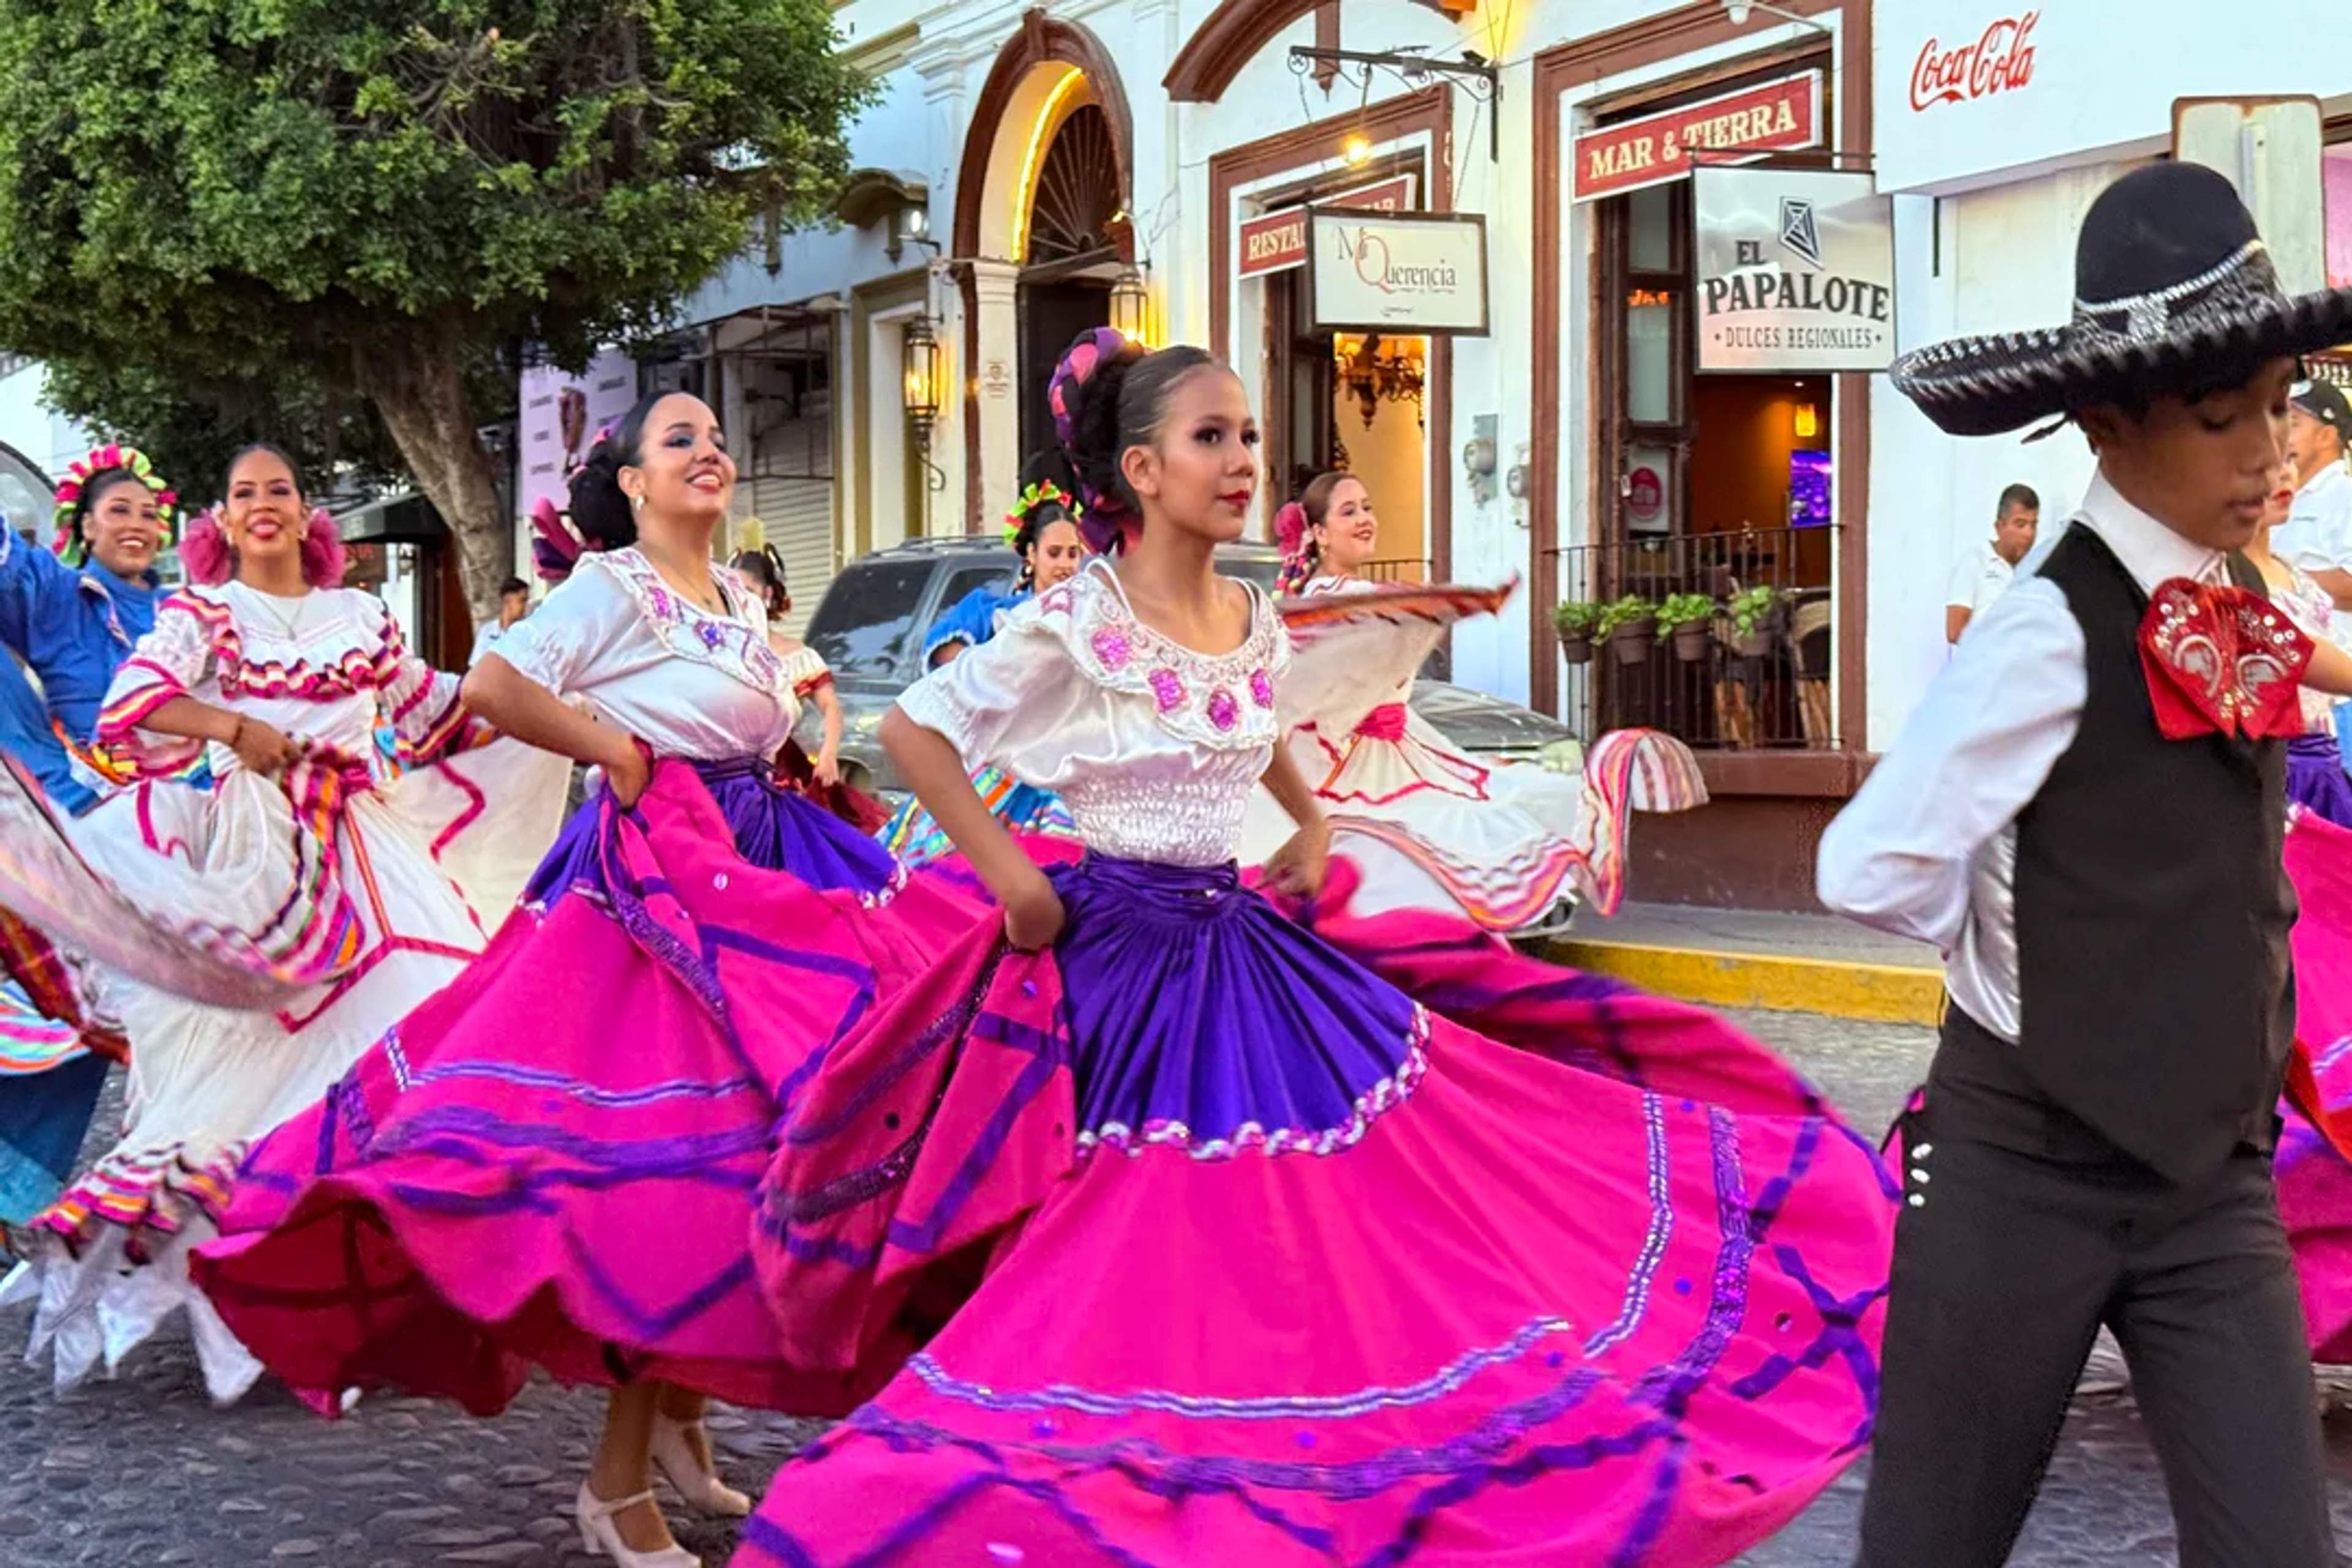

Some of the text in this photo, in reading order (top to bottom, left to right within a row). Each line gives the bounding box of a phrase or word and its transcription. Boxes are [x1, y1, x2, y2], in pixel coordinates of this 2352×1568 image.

[1589, 98, 1798, 180] MAR & TIERRA
[1355, 235, 1456, 294] Querencia
[1735, 240, 1768, 265] EL
[1704, 272, 1890, 322] PAPALOTE
[1725, 327, 1872, 349] DULCES REGIONALES
